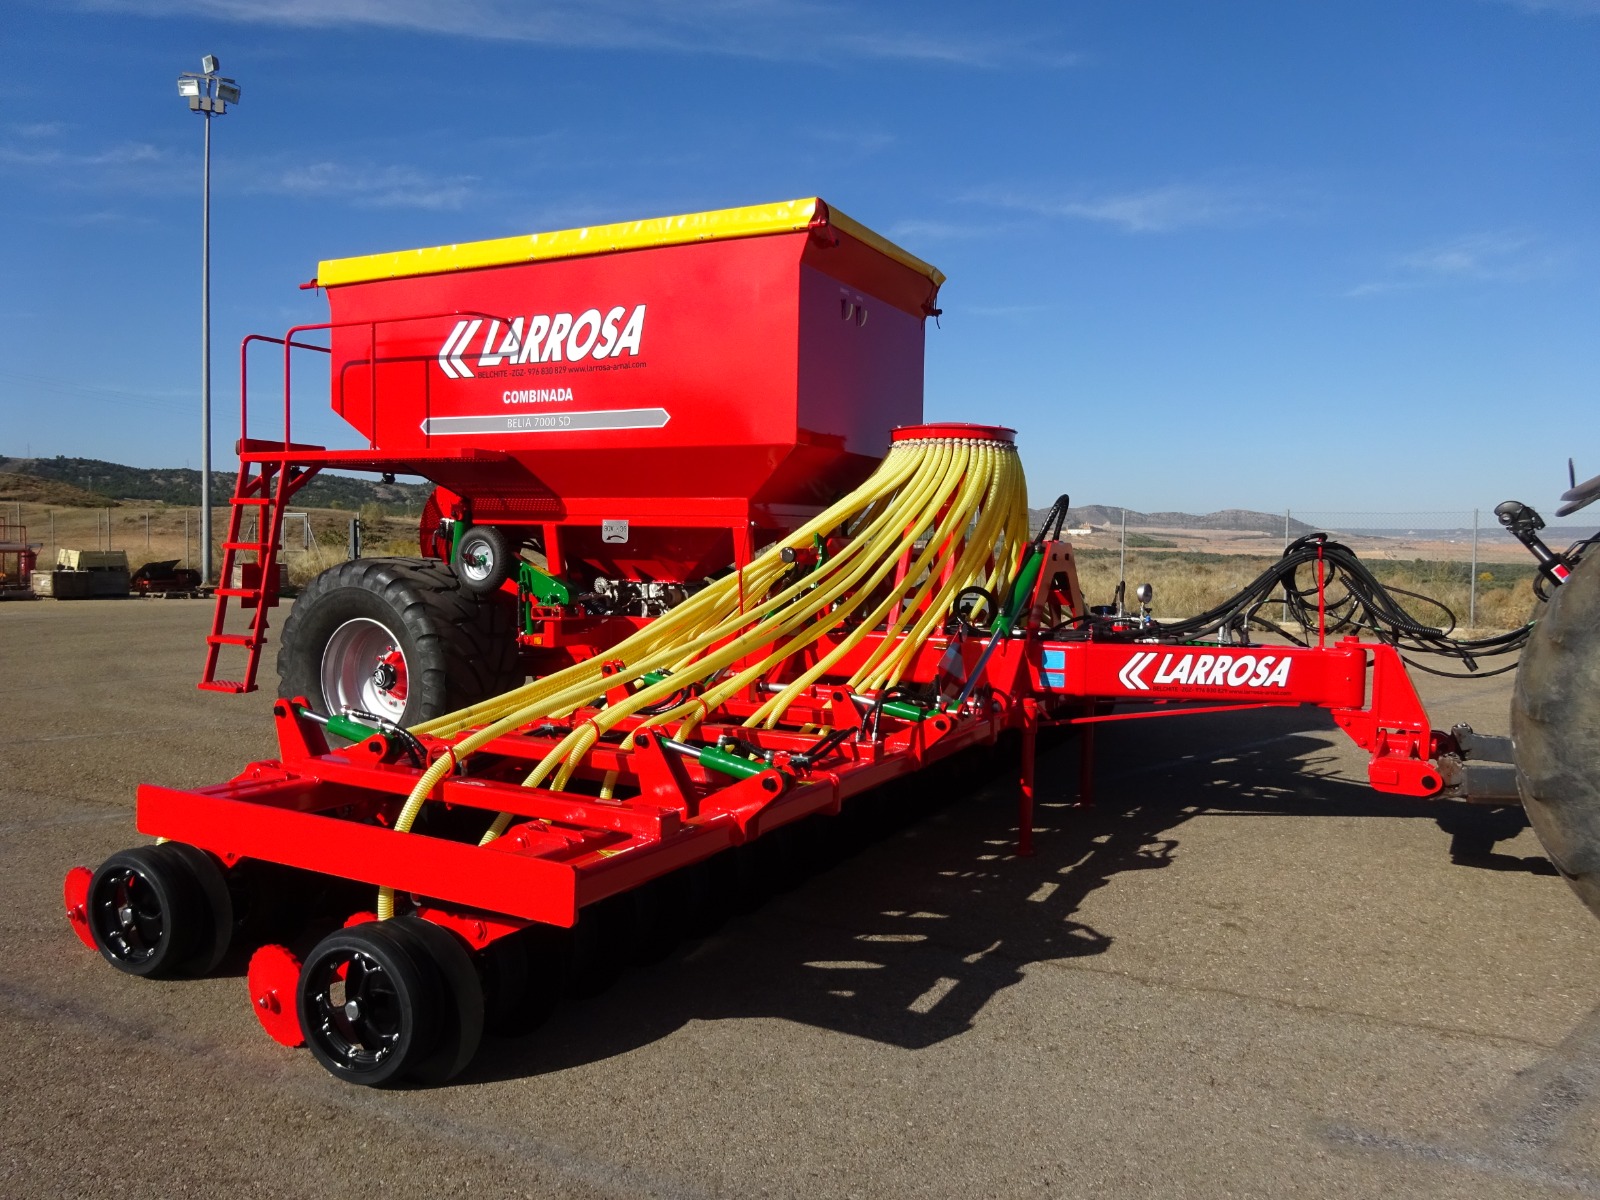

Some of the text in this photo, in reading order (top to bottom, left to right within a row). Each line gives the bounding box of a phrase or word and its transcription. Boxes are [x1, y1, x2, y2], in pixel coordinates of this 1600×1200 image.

[477, 304, 647, 367] LARROSA
[477, 370, 508, 379] BELCHITE
[528, 367, 540, 376] 976
[554, 366, 567, 375] 829
[568, 361, 647, 373] www.larrosa-arnal.com
[503, 388, 573, 404] COMBINADA
[507, 415, 571, 428] BELIA 7000 SD
[1153, 653, 1293, 687] LARROSA
